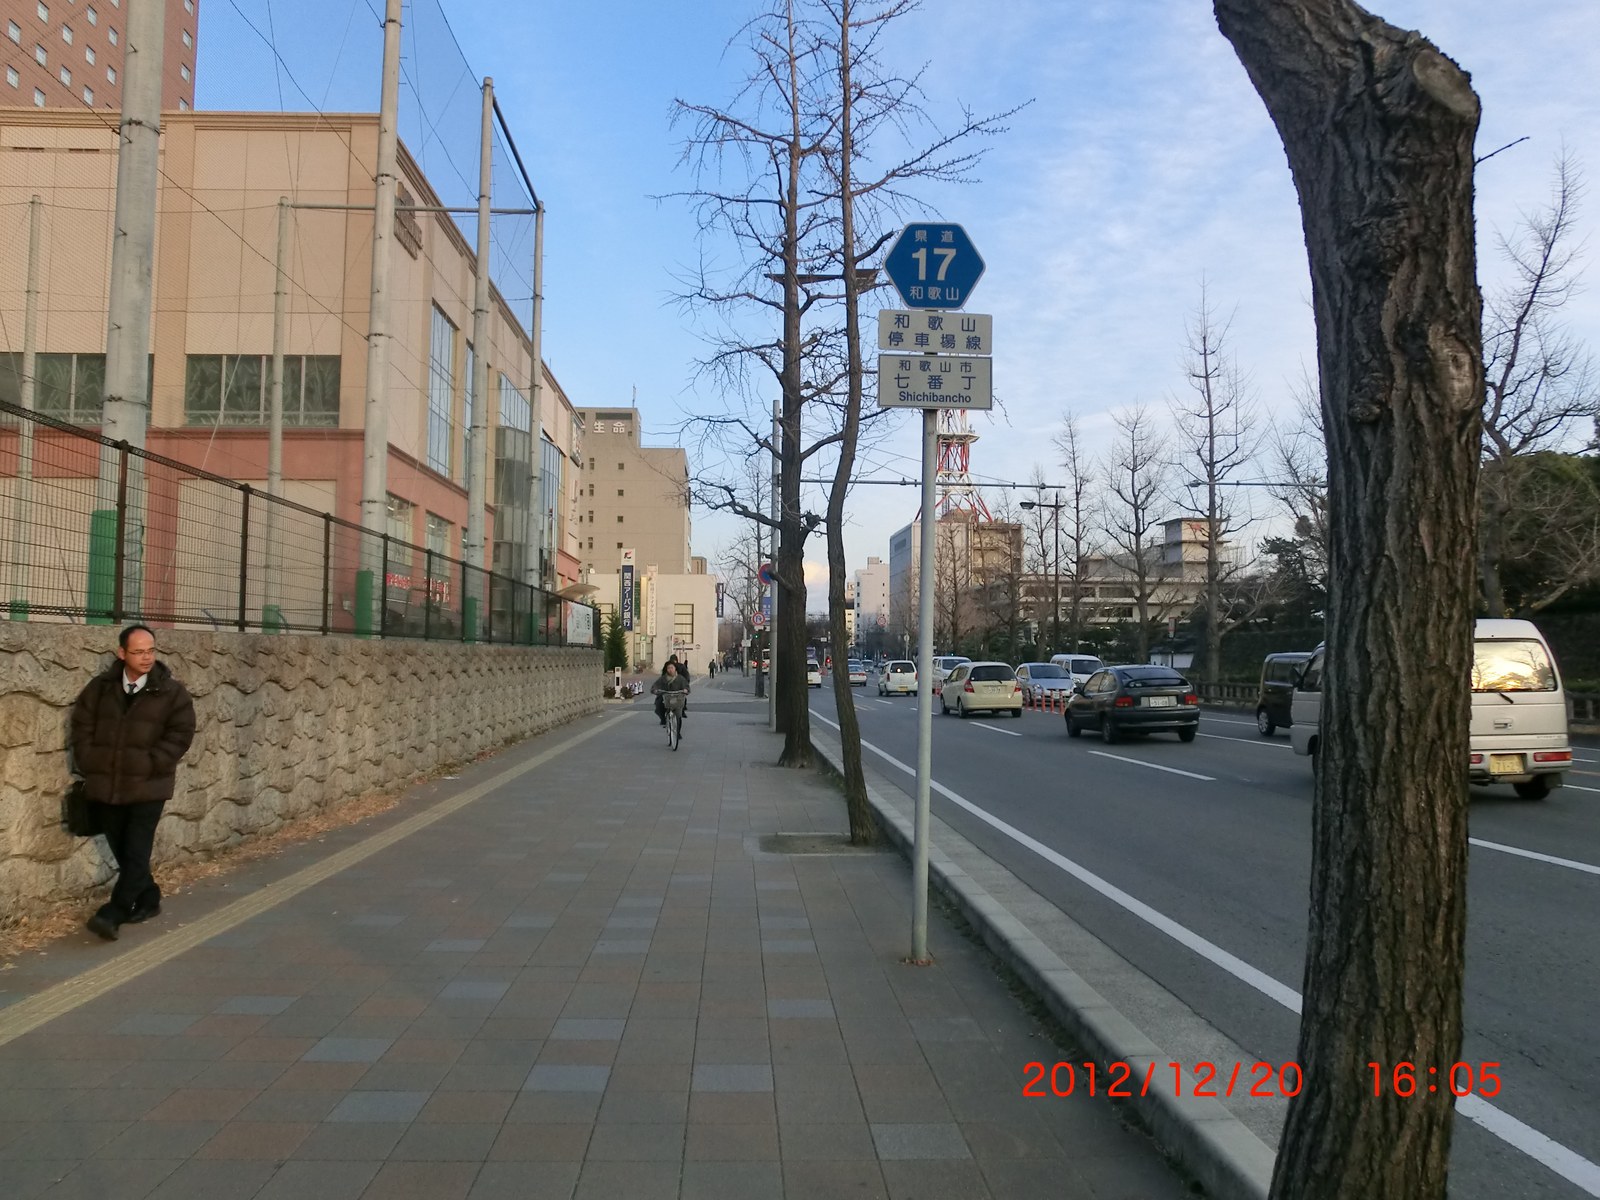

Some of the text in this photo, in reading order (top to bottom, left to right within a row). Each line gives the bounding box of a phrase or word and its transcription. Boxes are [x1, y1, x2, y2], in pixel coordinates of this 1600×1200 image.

[915, 229, 954, 243] 県道
[911, 248, 957, 281] 17
[910, 286, 960, 300] 和歌山
[894, 314, 976, 332] 和歌山
[888, 331, 982, 350] 停車場線
[899, 360, 972, 373] 和歌山市
[894, 374, 976, 390] 七番丁
[898, 391, 972, 403] Shichibancho
